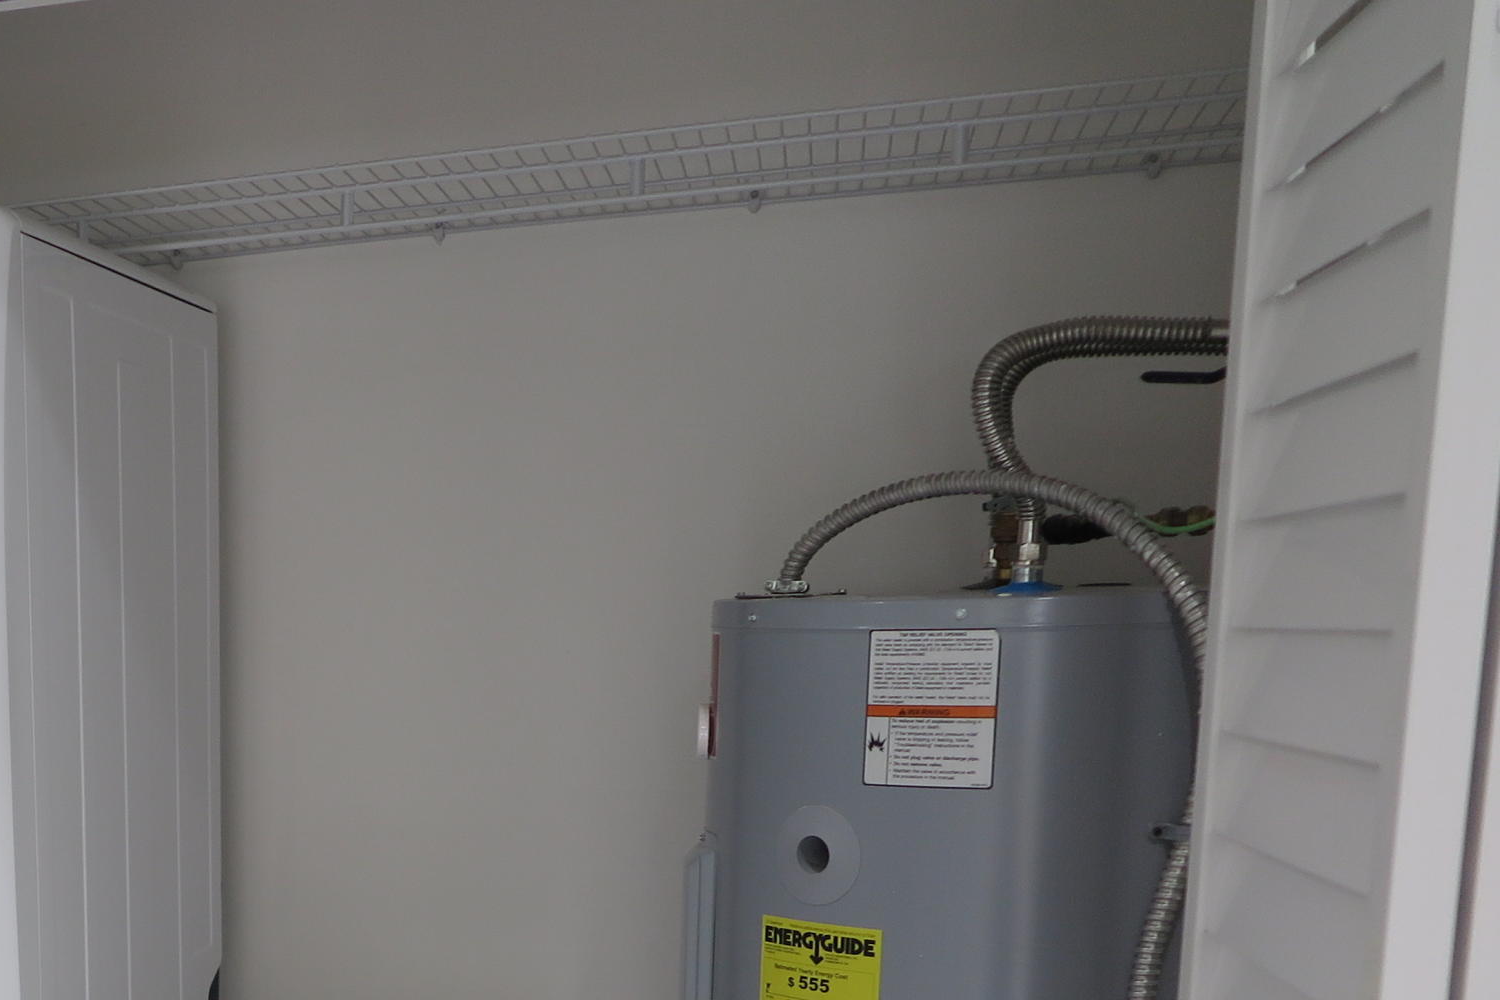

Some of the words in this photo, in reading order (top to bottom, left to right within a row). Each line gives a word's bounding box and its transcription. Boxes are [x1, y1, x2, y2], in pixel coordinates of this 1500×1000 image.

[765, 925, 876, 958] ENERGYGUIDE
[787, 977, 795, 988] $
[798, 976, 830, 994] 555
